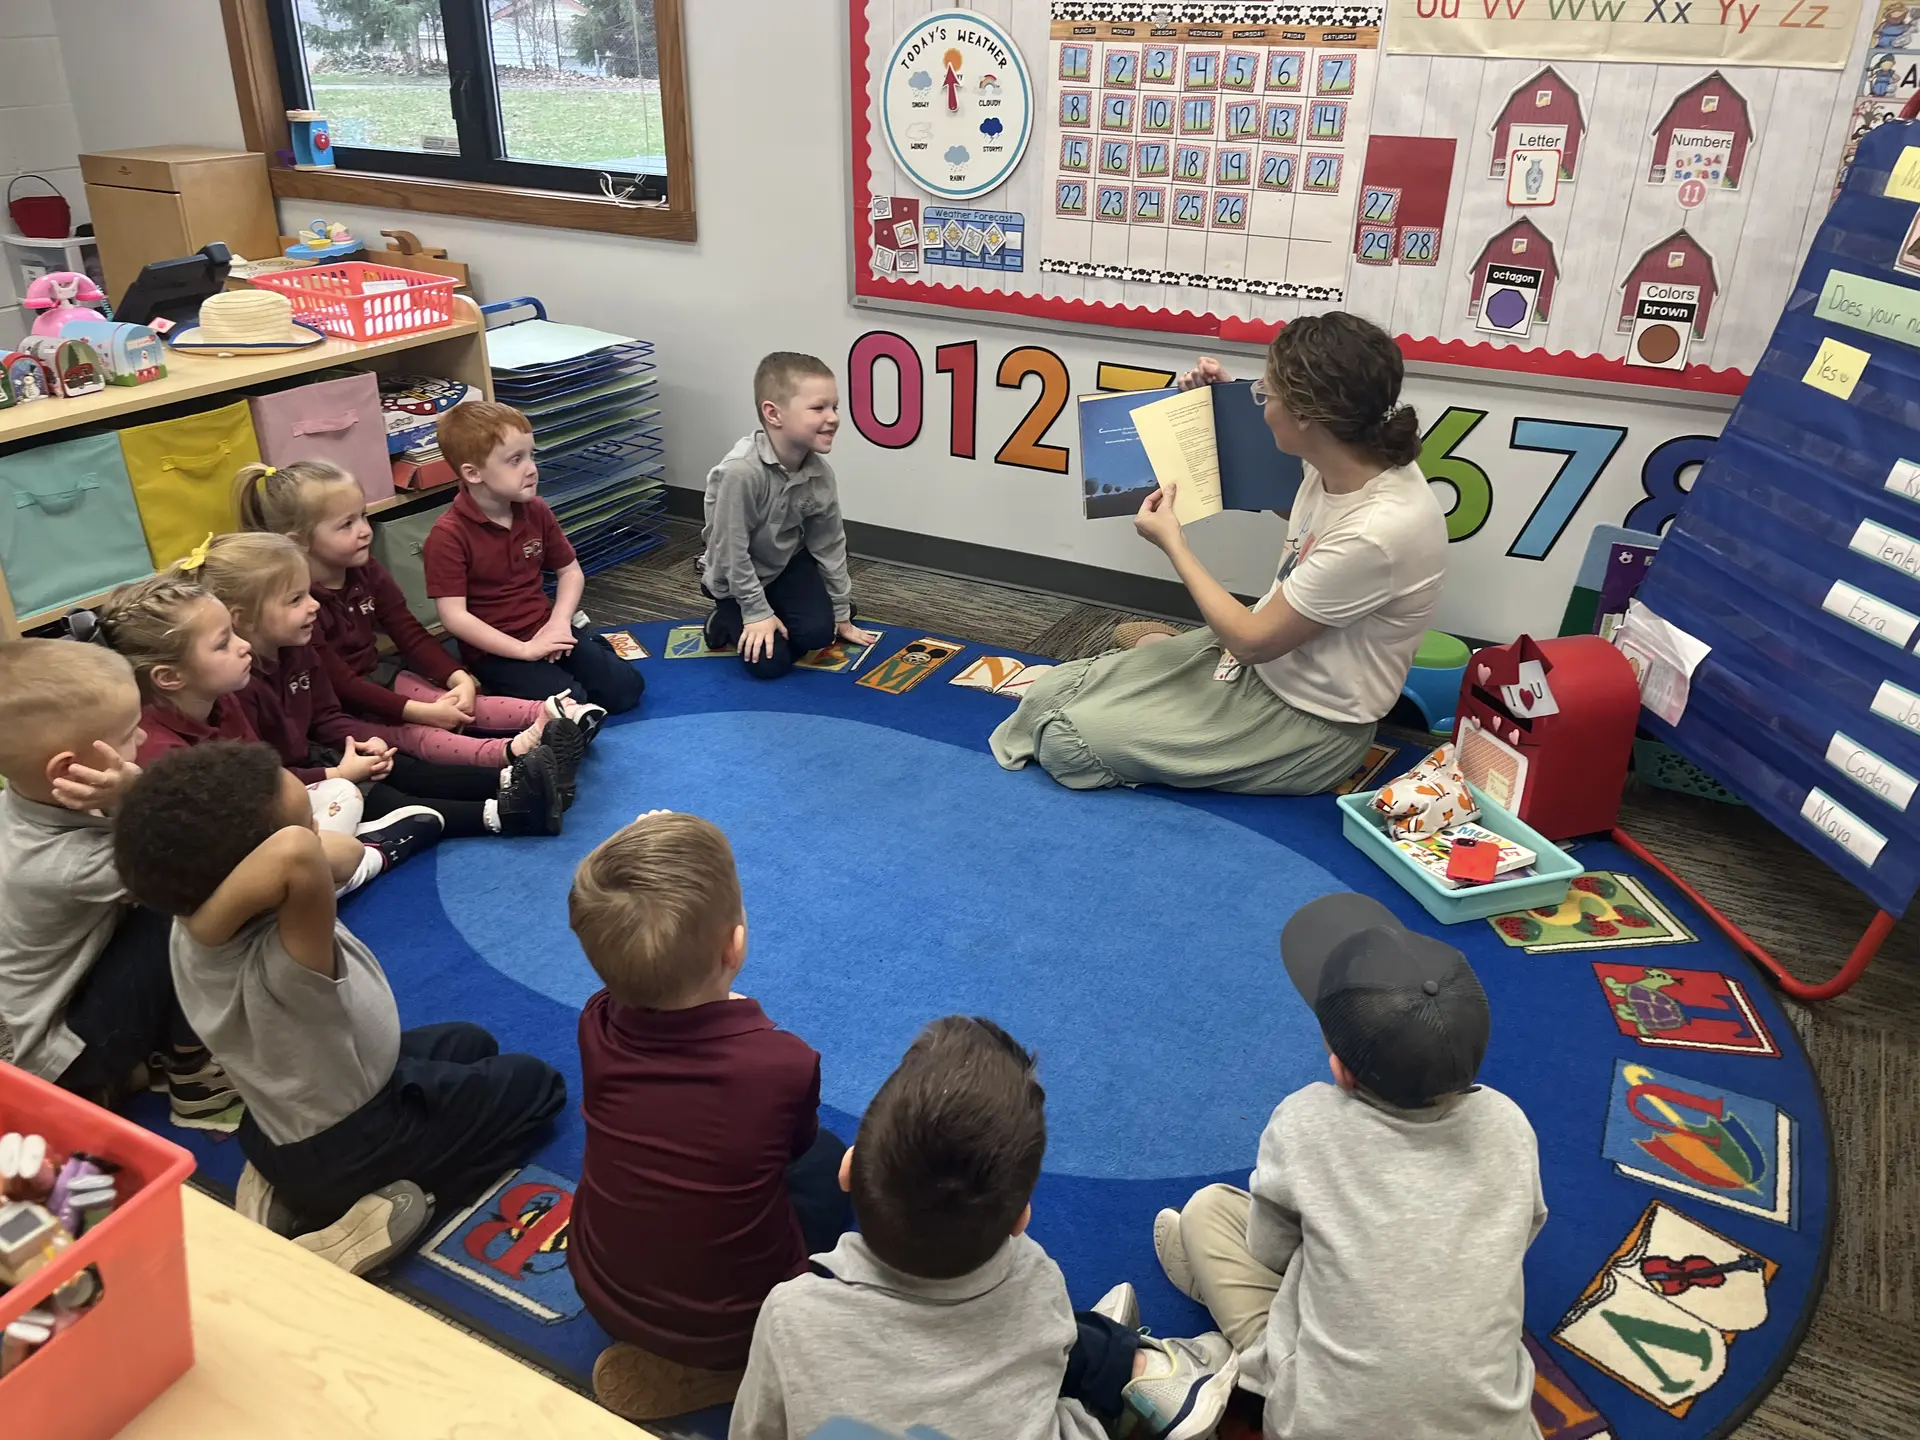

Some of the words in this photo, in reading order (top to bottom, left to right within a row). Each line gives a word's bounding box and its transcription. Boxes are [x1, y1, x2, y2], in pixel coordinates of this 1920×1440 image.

[1643, 0, 1692, 24] Xx
[1719, 0, 1760, 34] Yy
[901, 26, 947, 70] TODAY'S
[957, 29, 1008, 70] WEATHER
[1116, 57, 1127, 83] 2
[1153, 51, 1164, 78] 3
[1196, 57, 1207, 84] 4
[1234, 57, 1246, 85] 5
[1278, 57, 1290, 85] 6
[1329, 61, 1343, 89] 7
[1900, 63, 1920, 89] A
[978, 99, 1001, 107] CLOUDY
[1070, 96, 1080, 122] 8
[1112, 101, 1124, 126] 9
[1149, 101, 1166, 127] 10
[1234, 107, 1251, 134] 12
[1271, 110, 1290, 137] 13
[1317, 107, 1336, 135] 14
[1518, 132, 1561, 148] Letter
[1671, 133, 1732, 149] Numbers
[1068, 141, 1082, 167] 15
[1106, 144, 1122, 170] 16
[1144, 146, 1161, 172] 17
[1184, 150, 1199, 177] 18
[1224, 153, 1241, 179] 19
[1263, 157, 1291, 185] 20
[1314, 159, 1332, 186] 21
[1516, 153, 1528, 162] Vv
[1901, 160, 1920, 190] M
[1061, 185, 1081, 210] 22
[1101, 190, 1123, 216] 23
[1137, 191, 1160, 217] 24
[1178, 195, 1199, 221] 25
[1217, 197, 1241, 224] 26
[1364, 192, 1394, 220] 27
[1682, 184, 1701, 203] 11
[935, 209, 971, 220] Weather
[973, 213, 1013, 223] Forecast
[1362, 232, 1390, 260] 29
[1405, 233, 1431, 260] 28
[1492, 270, 1535, 284] octagon
[1646, 285, 1695, 301] Colors
[1828, 284, 1863, 317] Does
[1867, 306, 1901, 327] your
[1643, 303, 1688, 318] brown
[1816, 353, 1838, 382] Yes
[847, 330, 924, 450] 0
[935, 339, 978, 460] 1
[994, 345, 1071, 475] 2
[1420, 405, 1493, 544] 6
[1504, 416, 1629, 562] 7
[1847, 596, 1887, 634] Ezra
[860, 658, 931, 689] M
[956, 656, 1022, 689] N
[1530, 681, 1543, 700] U
[1845, 750, 1892, 797] Caden
[1811, 799, 1852, 846] Maya
